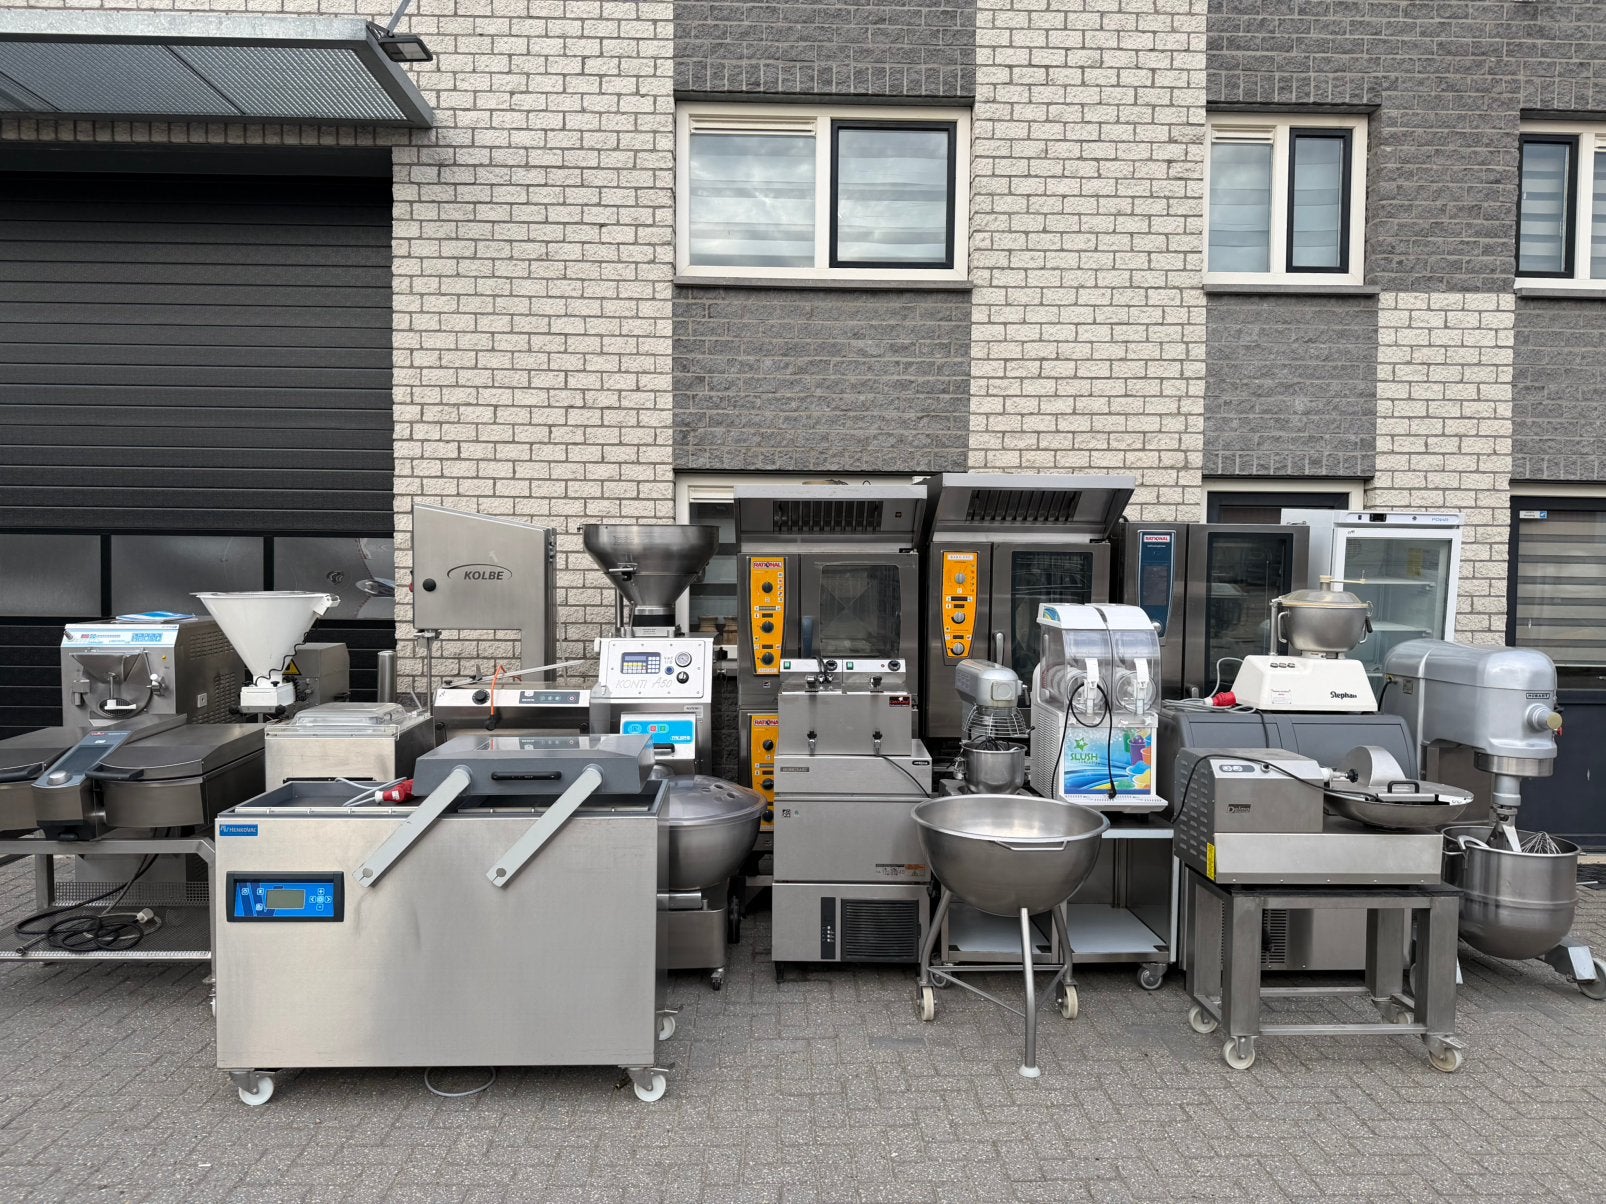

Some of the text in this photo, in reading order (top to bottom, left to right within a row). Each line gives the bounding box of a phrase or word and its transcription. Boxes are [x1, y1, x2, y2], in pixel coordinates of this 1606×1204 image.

[464, 571, 505, 580] KOLBE
[615, 679, 648, 688] KONTI
[1330, 690, 1358, 700] Stephan
[1070, 753, 1099, 761] SLUSH
